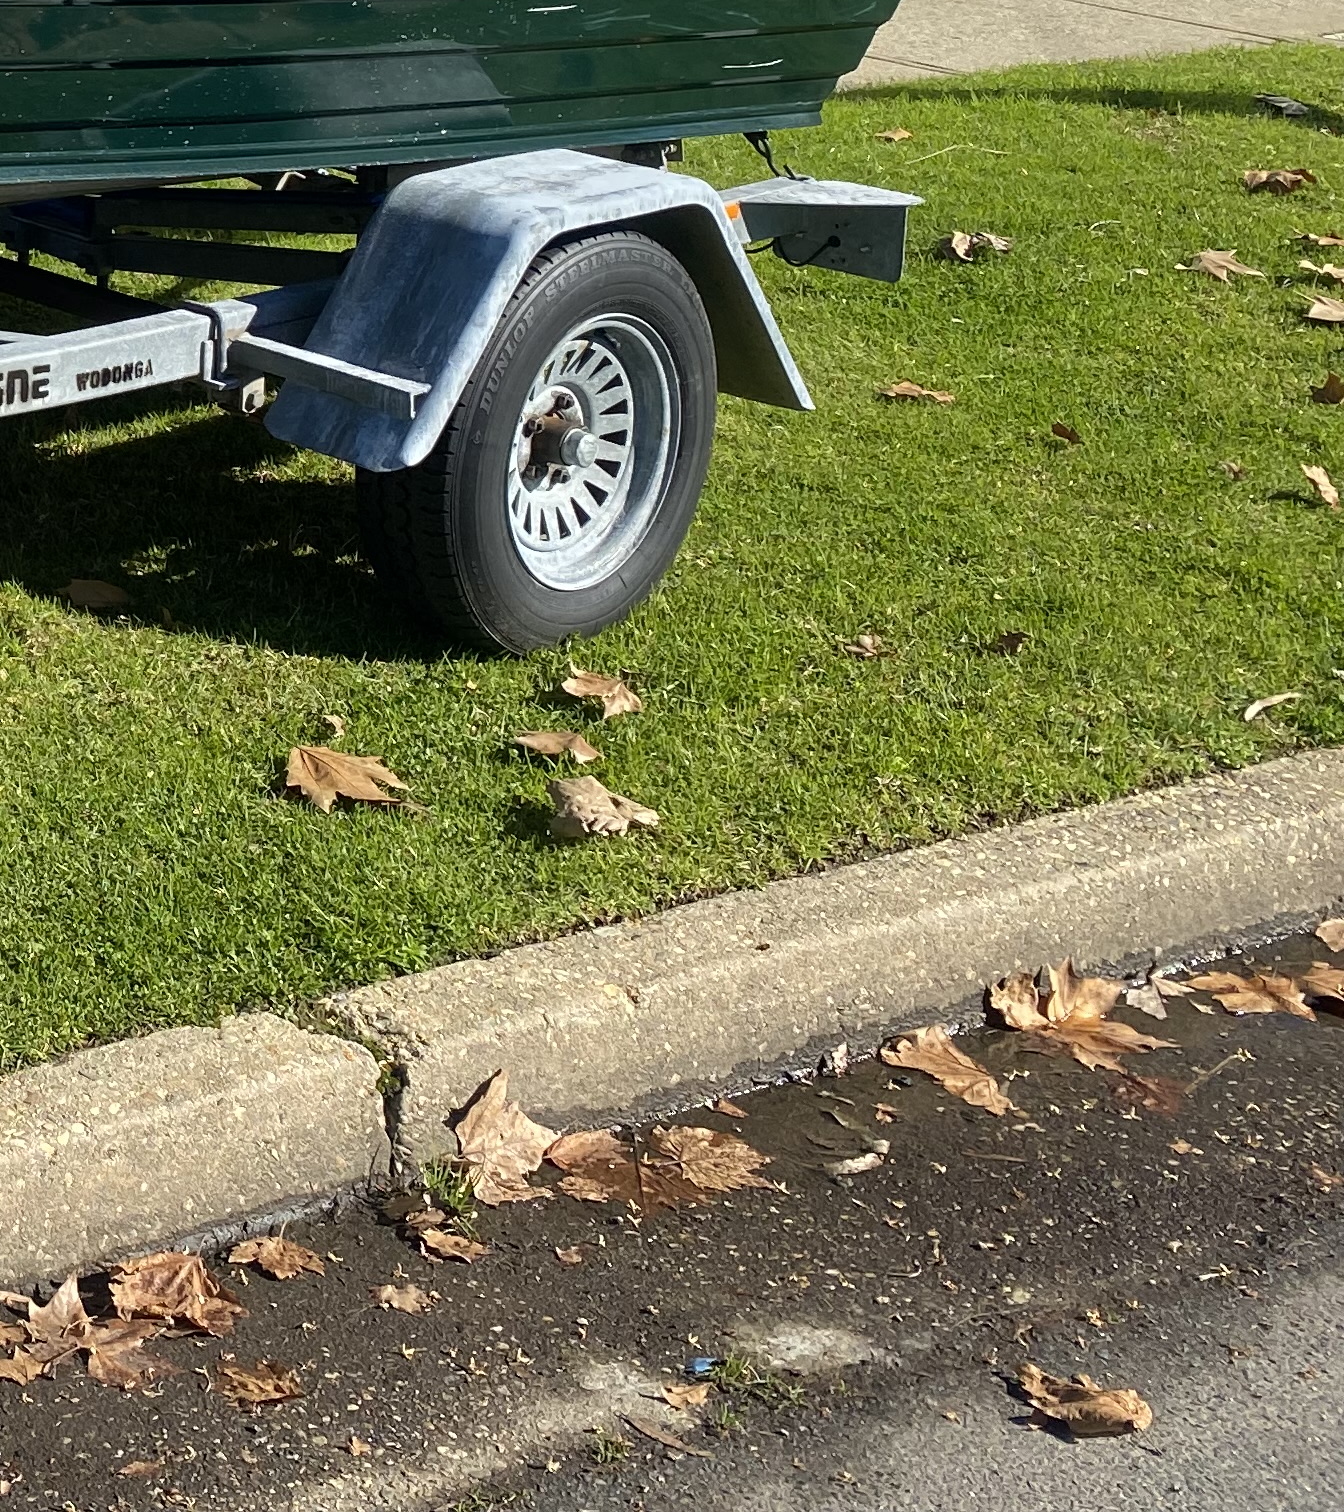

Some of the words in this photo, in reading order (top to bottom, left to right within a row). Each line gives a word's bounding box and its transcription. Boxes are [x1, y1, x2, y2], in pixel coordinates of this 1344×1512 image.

[543, 248, 676, 304] STEELMASTER
[75, 357, 155, 392] WODONGA
[479, 306, 537, 417] DUNLOP
